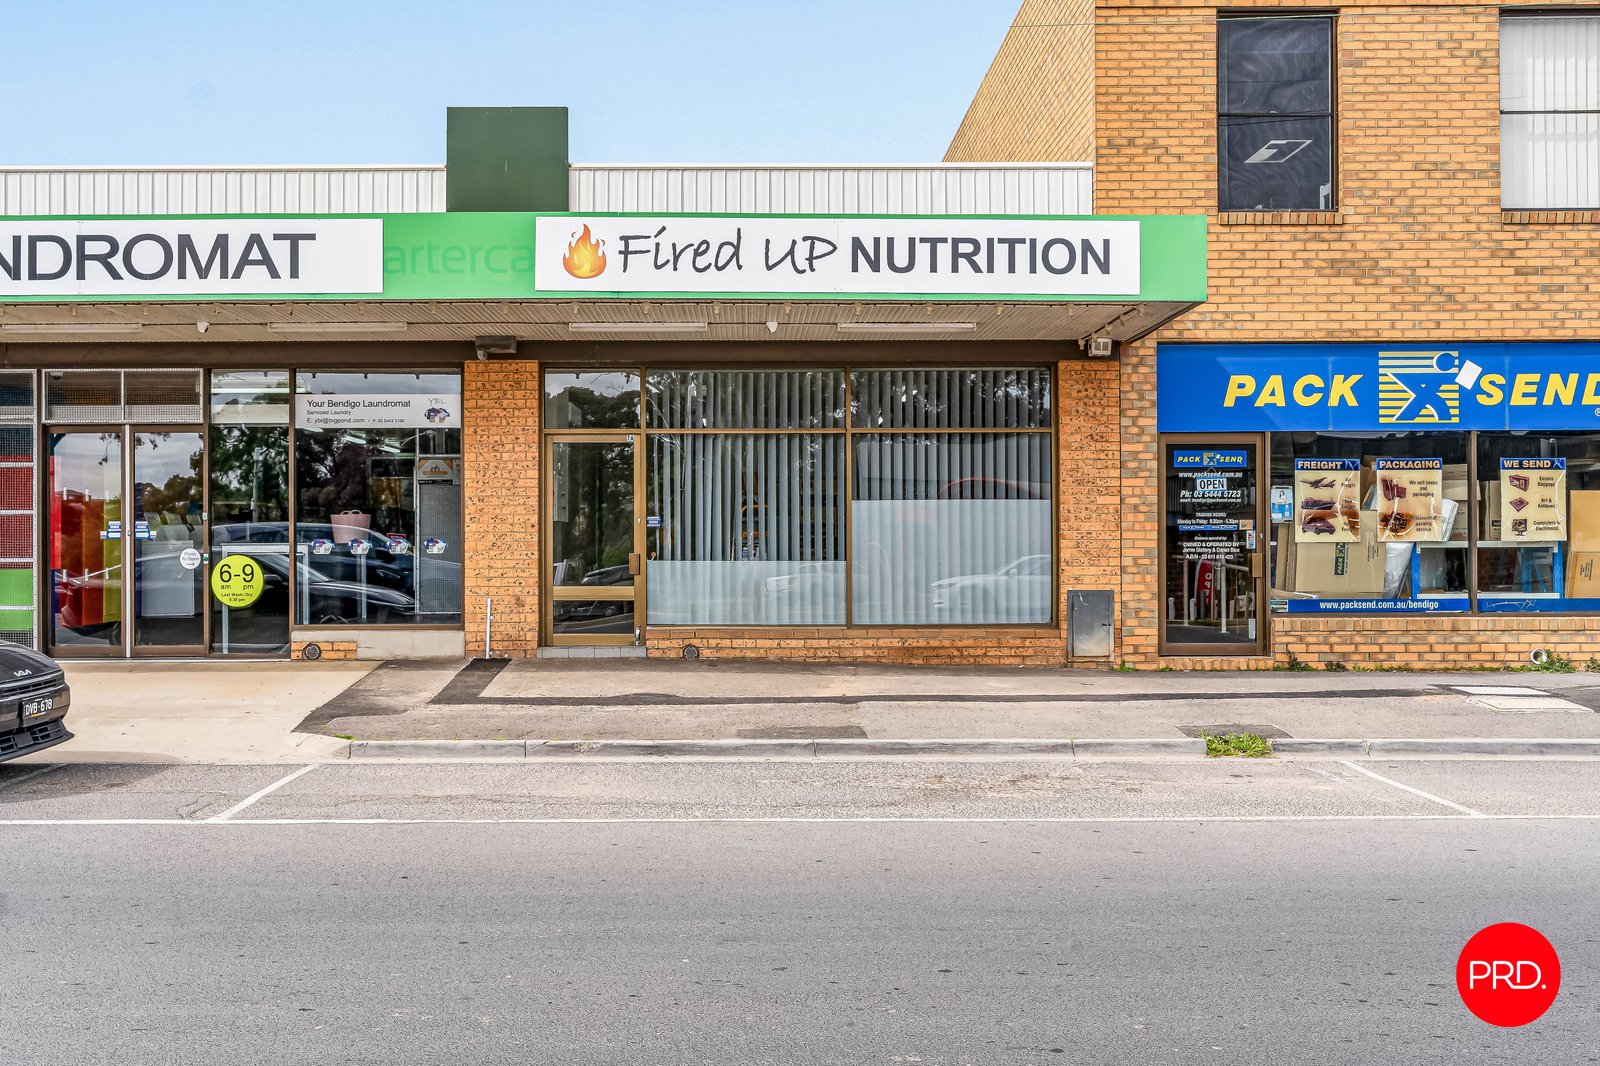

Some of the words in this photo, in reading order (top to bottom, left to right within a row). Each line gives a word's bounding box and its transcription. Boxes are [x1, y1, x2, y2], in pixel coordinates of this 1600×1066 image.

[618, 225, 743, 273] Fired
[764, 235, 838, 275] UP
[851, 236, 1111, 275] NUTRITION
[1223, 374, 1363, 407] PACK
[1475, 373, 1600, 406] SEND
[307, 399, 325, 408] Your
[327, 399, 360, 410] Bendigo
[362, 399, 411, 408] Laundromat
[1297, 461, 1342, 470] FREIGHT
[1379, 460, 1440, 469] PACKAGING
[1503, 459, 1519, 468] WE
[1522, 459, 1551, 468] SEND
[1199, 479, 1224, 490] OPEN
[1193, 490, 1203, 498] 03
[1223, 490, 1241, 498] 5723
[1319, 600, 1439, 611] www.packsend.com.au/bendigo
